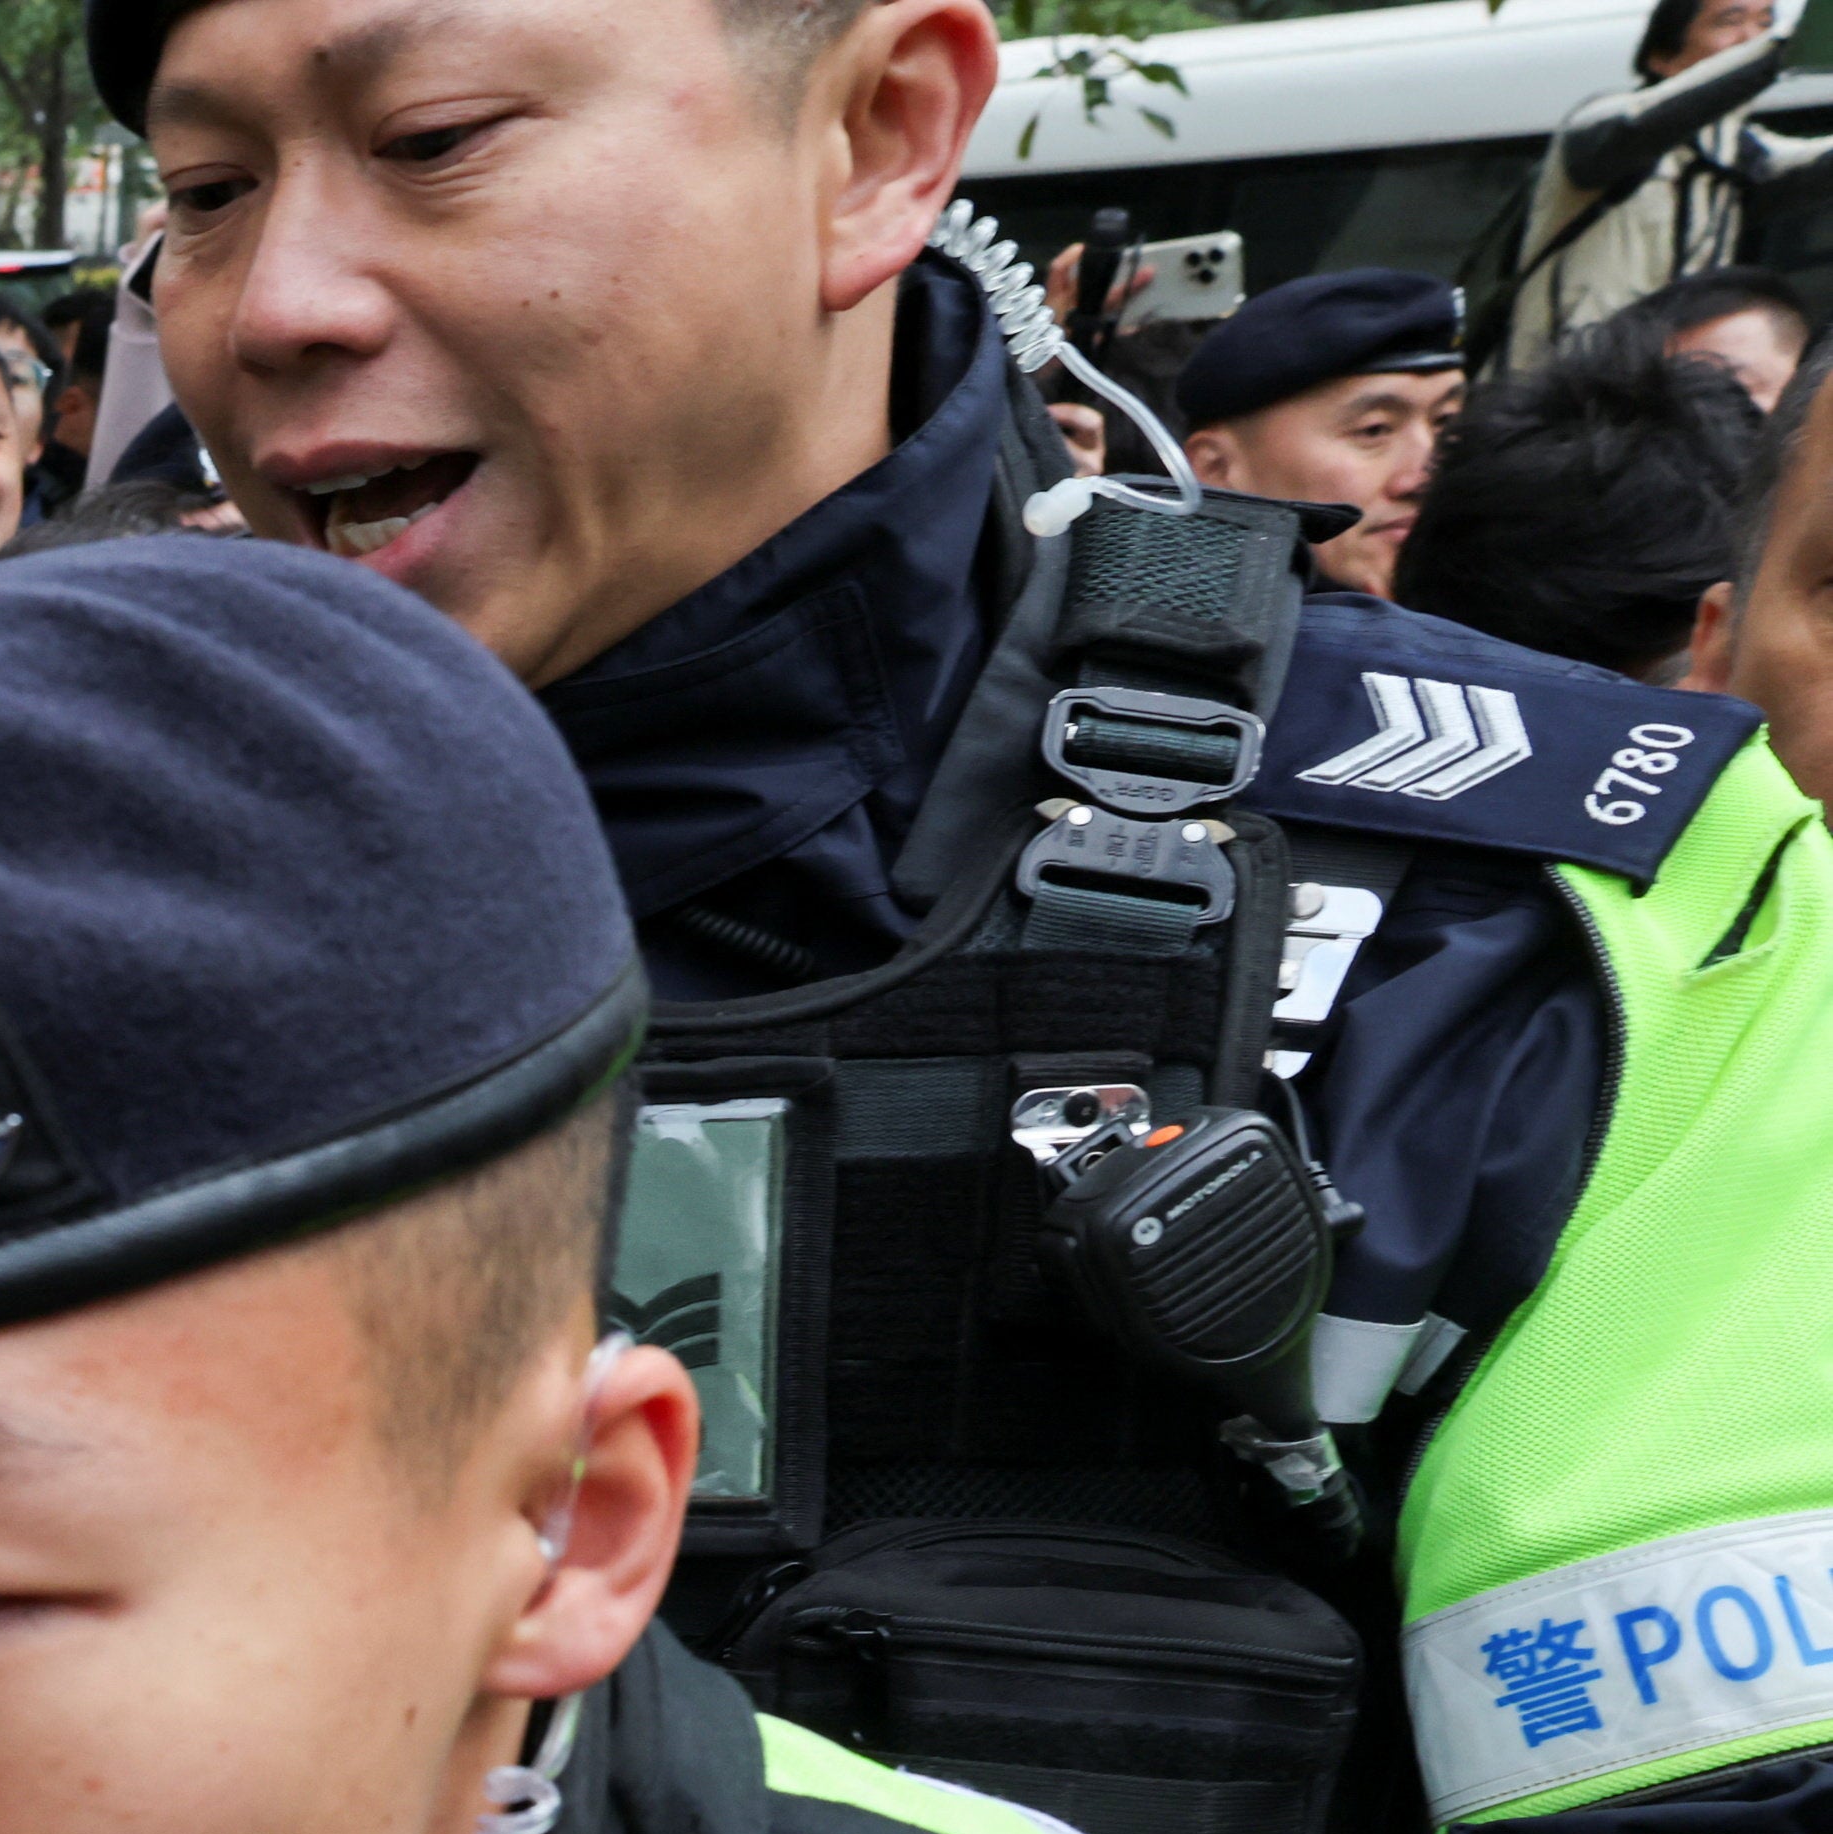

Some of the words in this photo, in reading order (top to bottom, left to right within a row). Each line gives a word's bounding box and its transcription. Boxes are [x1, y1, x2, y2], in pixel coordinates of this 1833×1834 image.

[1584, 722, 1696, 826] 6780
[1165, 1150, 1264, 1222] MOTOROLA
[1479, 1616, 1604, 1749] 警
[1613, 1567, 1833, 1707] POL
